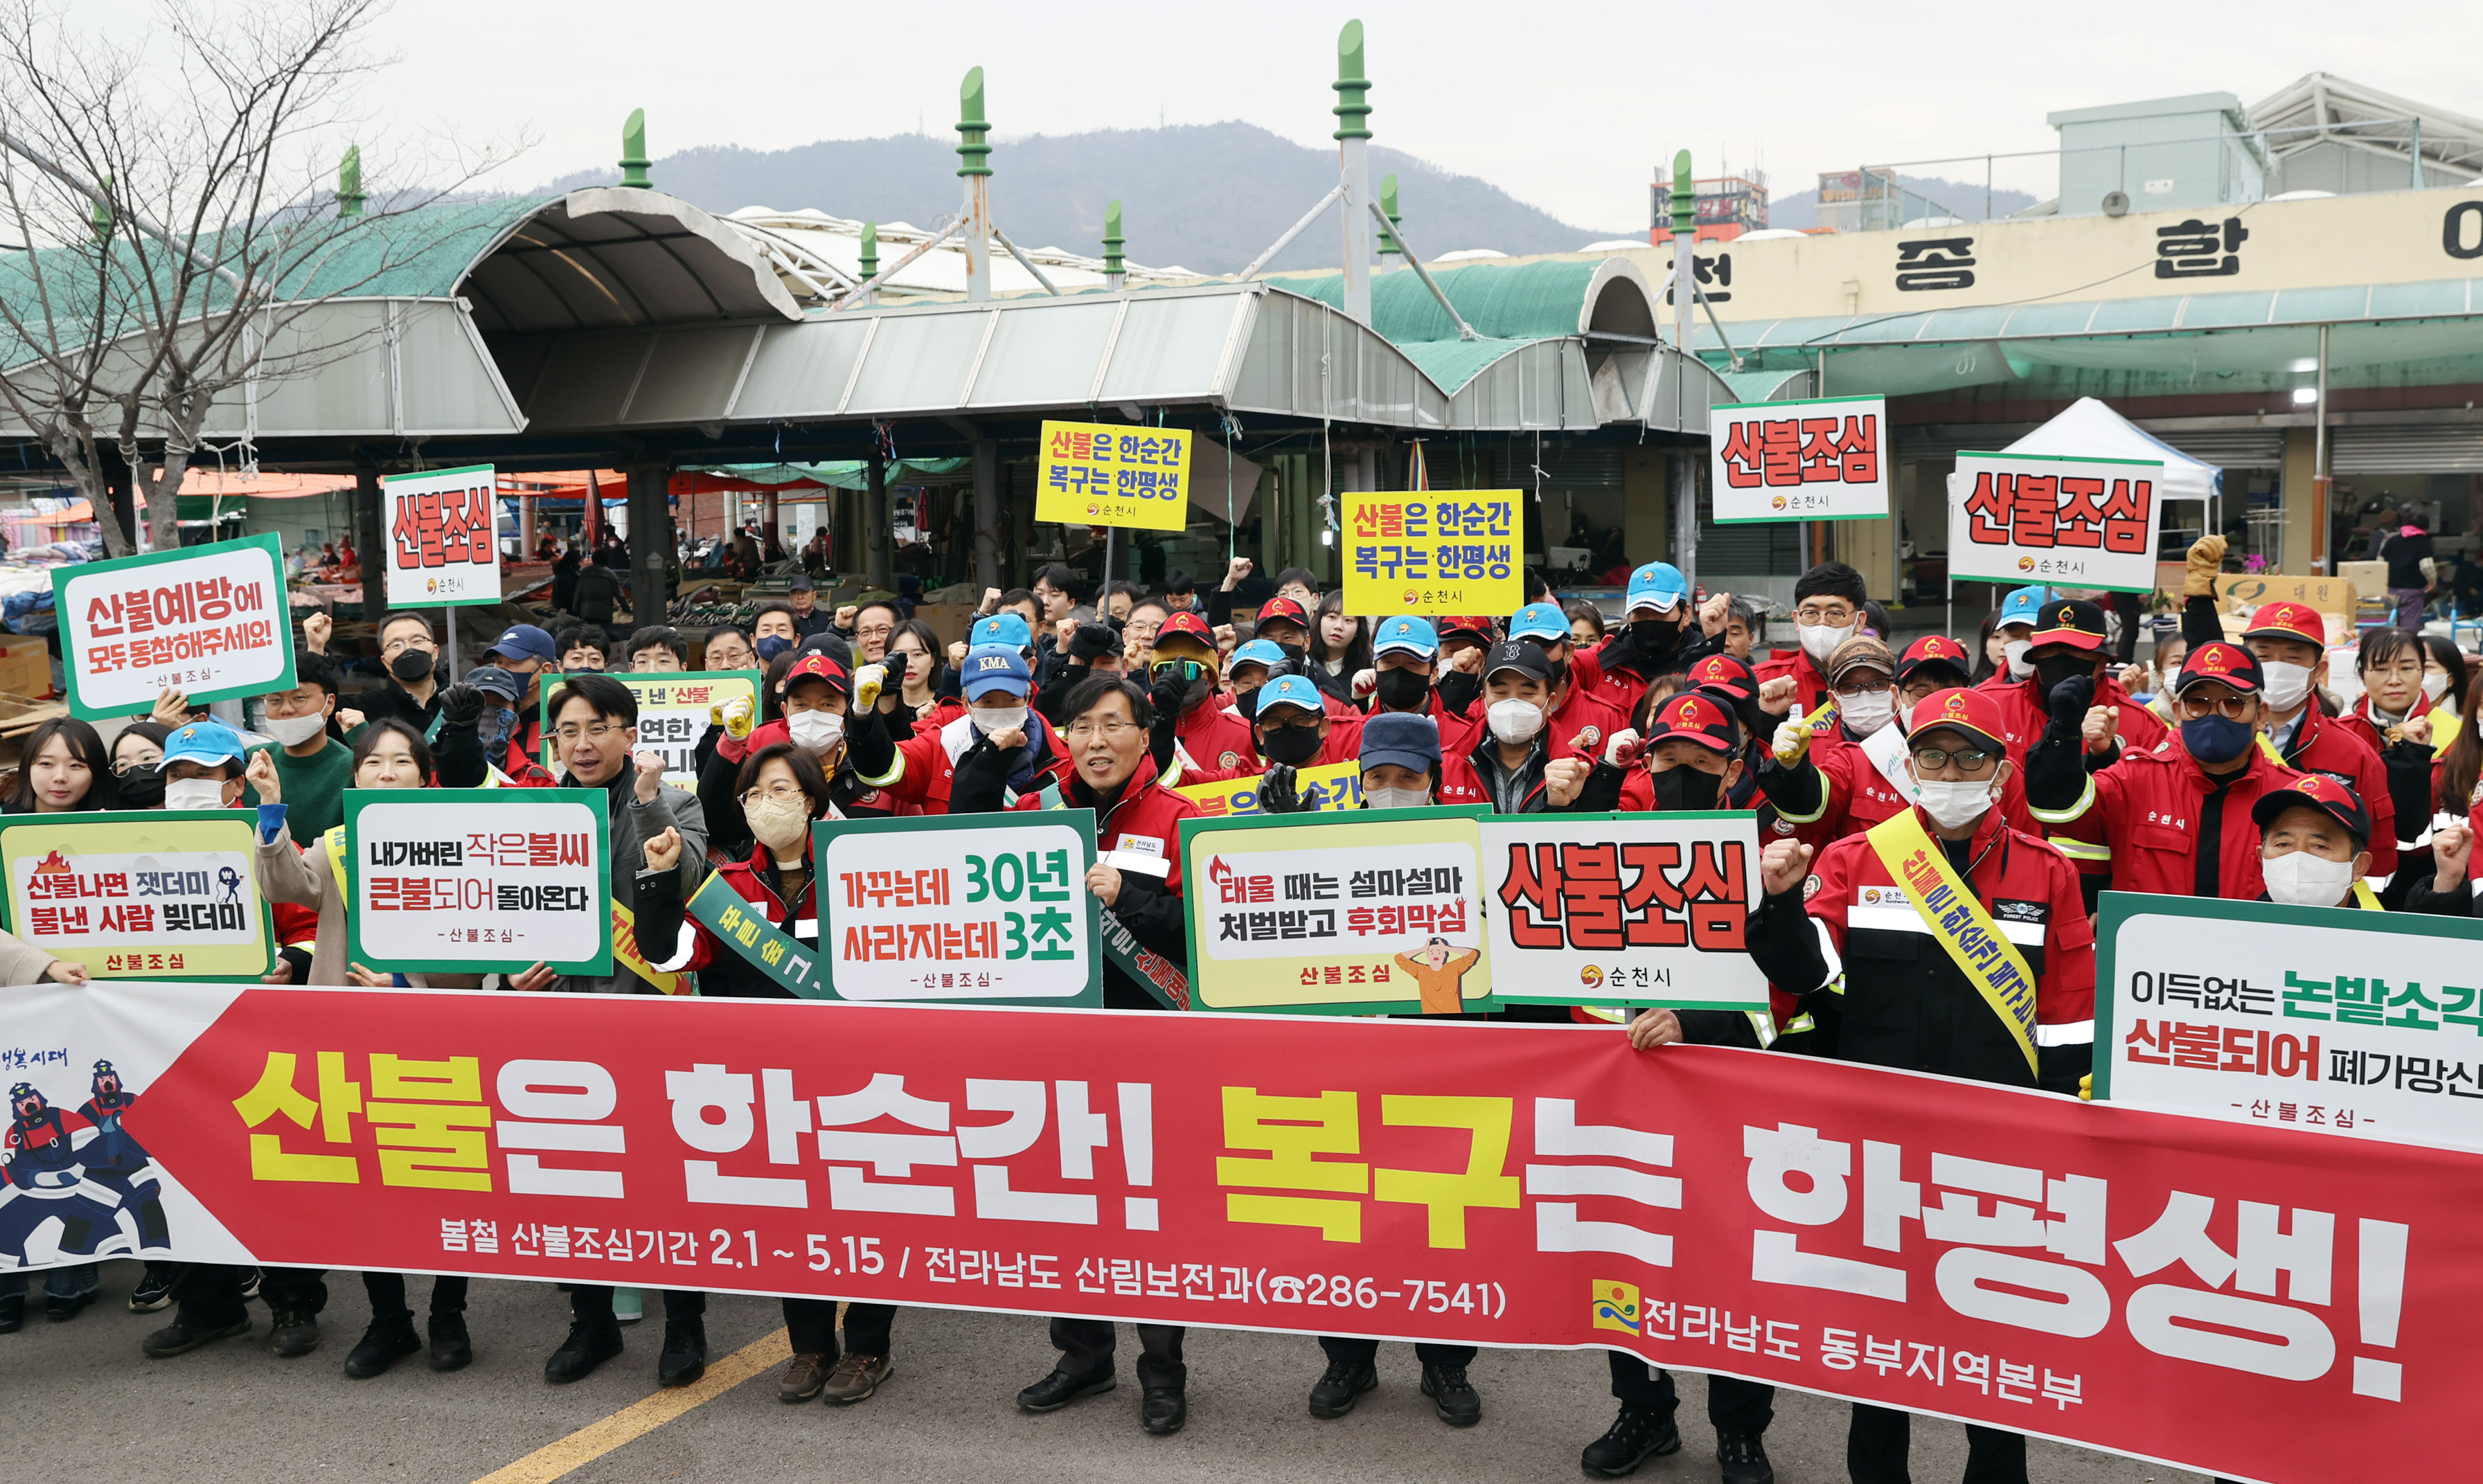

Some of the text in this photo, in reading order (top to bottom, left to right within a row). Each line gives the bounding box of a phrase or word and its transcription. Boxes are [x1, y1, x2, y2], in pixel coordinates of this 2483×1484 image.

[1051, 431, 1182, 466] 산불은 한순간
[1720, 414, 1878, 488] 산불조심
[1049, 465, 1178, 501] 복구는 한평생
[1103, 505, 1136, 517] 순천시
[1353, 502, 1511, 537] 산불은 한순간
[1790, 495, 1829, 509] 순천시
[1964, 472, 2152, 555] 산불조심
[393, 486, 493, 570] 산불조심
[1355, 545, 1511, 580] 복구는 한평생
[2039, 560, 2085, 575] 순천시
[439, 578, 464, 593] 순천시
[1422, 590, 1463, 603] 순천시
[87, 576, 262, 638] 산불예방에
[88, 620, 274, 674] 모두 동참해주세요!
[978, 656, 1011, 672] KMA
[649, 688, 666, 705] 낸
[634, 717, 693, 744] 연한
[1443, 785, 1477, 798] 순천시
[1866, 786, 1898, 803] 순천시
[2148, 810, 2186, 830] 순천시
[371, 840, 463, 867] 내가버린
[1136, 839, 1157, 848] 전라남도
[27, 869, 210, 900] 산불나면 잿더미
[369, 877, 589, 912] 큰불되어 돌아온다
[840, 848, 1070, 909] 가꾸는데 30년
[1220, 866, 1463, 904] 태울 때는 설마설마
[1885, 891, 1908, 900] 순천
[1497, 841, 1750, 952] 산불조심
[1903, 848, 1957, 915] 산불은
[1939, 904, 2002, 972] 한순간
[31, 902, 247, 936] 불낸 사람 빚더미
[718, 904, 761, 949] 푸른
[844, 906, 1075, 962] 사라지는데 3초
[1219, 902, 1467, 942] 처벌받고 후회막심
[106, 954, 185, 971] 산불조심
[1300, 964, 1391, 987] 산불조심
[1609, 967, 1671, 988] 순천시
[2131, 969, 2275, 1015] 이득없는
[2125, 1017, 2483, 1099] 산불되어 폐가망신
[232, 1051, 2410, 1403] 산불은 한순간! 복구는 한평생!
[440, 1217, 499, 1254] 봄철
[511, 1222, 699, 1267] 산불조심기간
[709, 1228, 758, 1270] 2.1
[808, 1233, 884, 1276] 5.15
[925, 1246, 1062, 1290] 전라남도
[1644, 1295, 2085, 1412] 전라남도 동부지역본부
